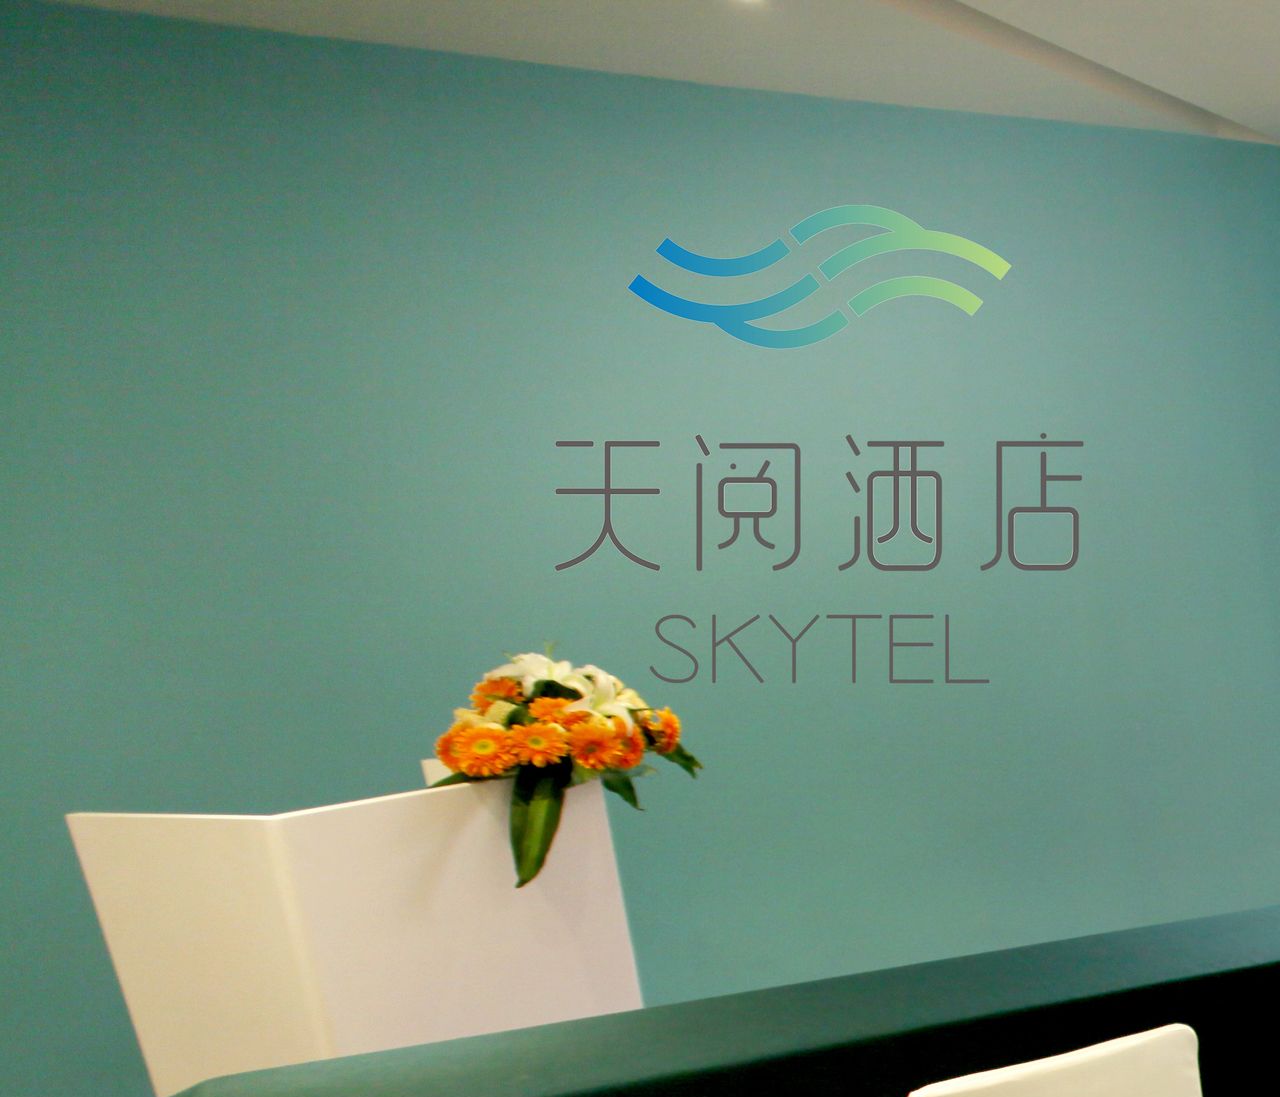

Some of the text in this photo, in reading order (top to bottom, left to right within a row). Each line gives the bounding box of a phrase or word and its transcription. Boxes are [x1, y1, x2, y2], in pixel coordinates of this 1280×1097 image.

[555, 432, 1084, 571] 天阅酒店
[649, 614, 990, 684] SKYTEL
